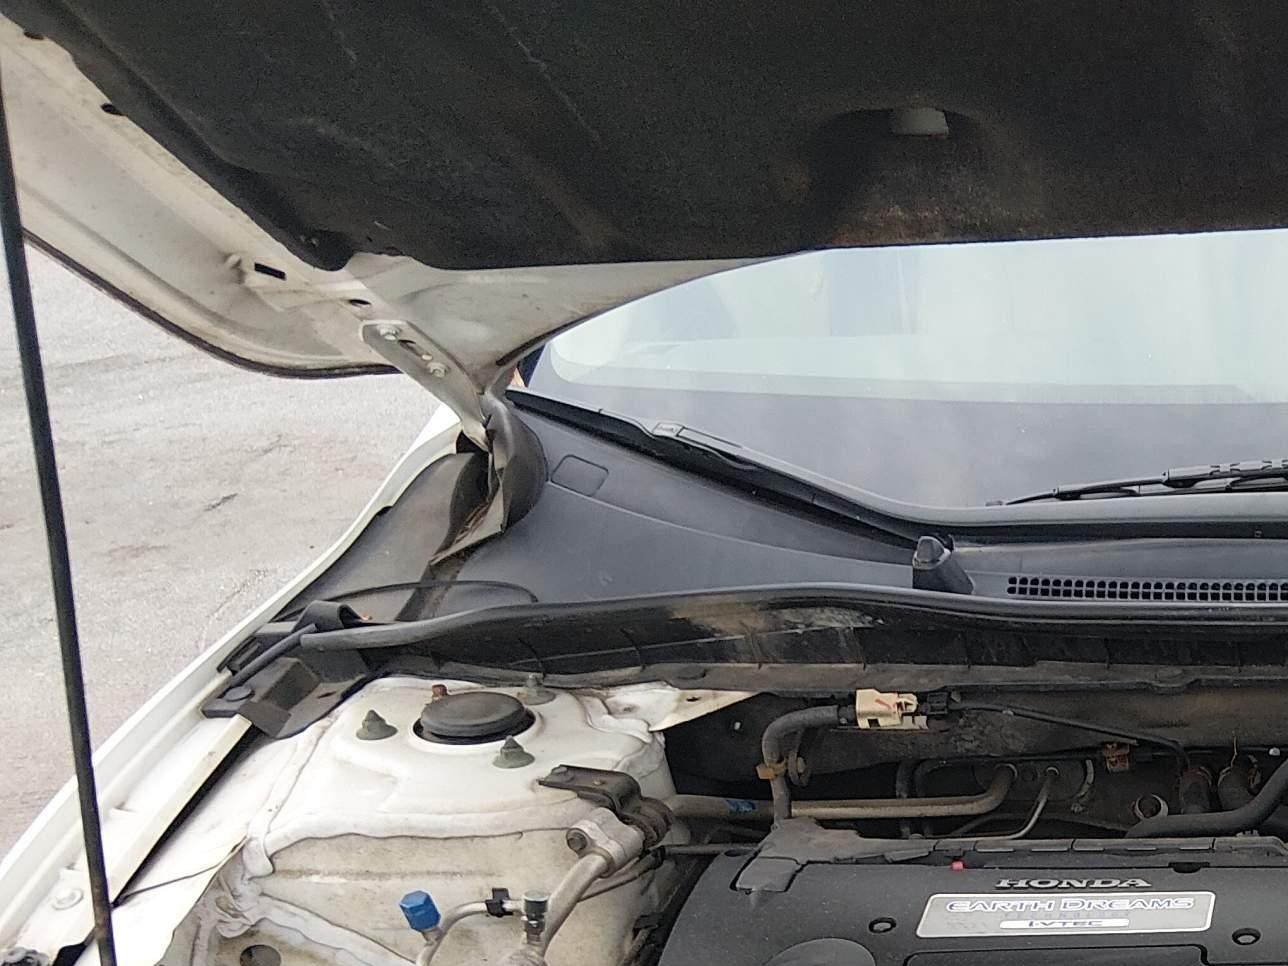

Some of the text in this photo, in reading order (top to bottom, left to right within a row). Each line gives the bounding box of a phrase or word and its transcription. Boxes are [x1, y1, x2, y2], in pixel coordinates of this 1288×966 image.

[996, 878, 1152, 889] HONDA
[946, 898, 1194, 913] EARTH DREAMS
